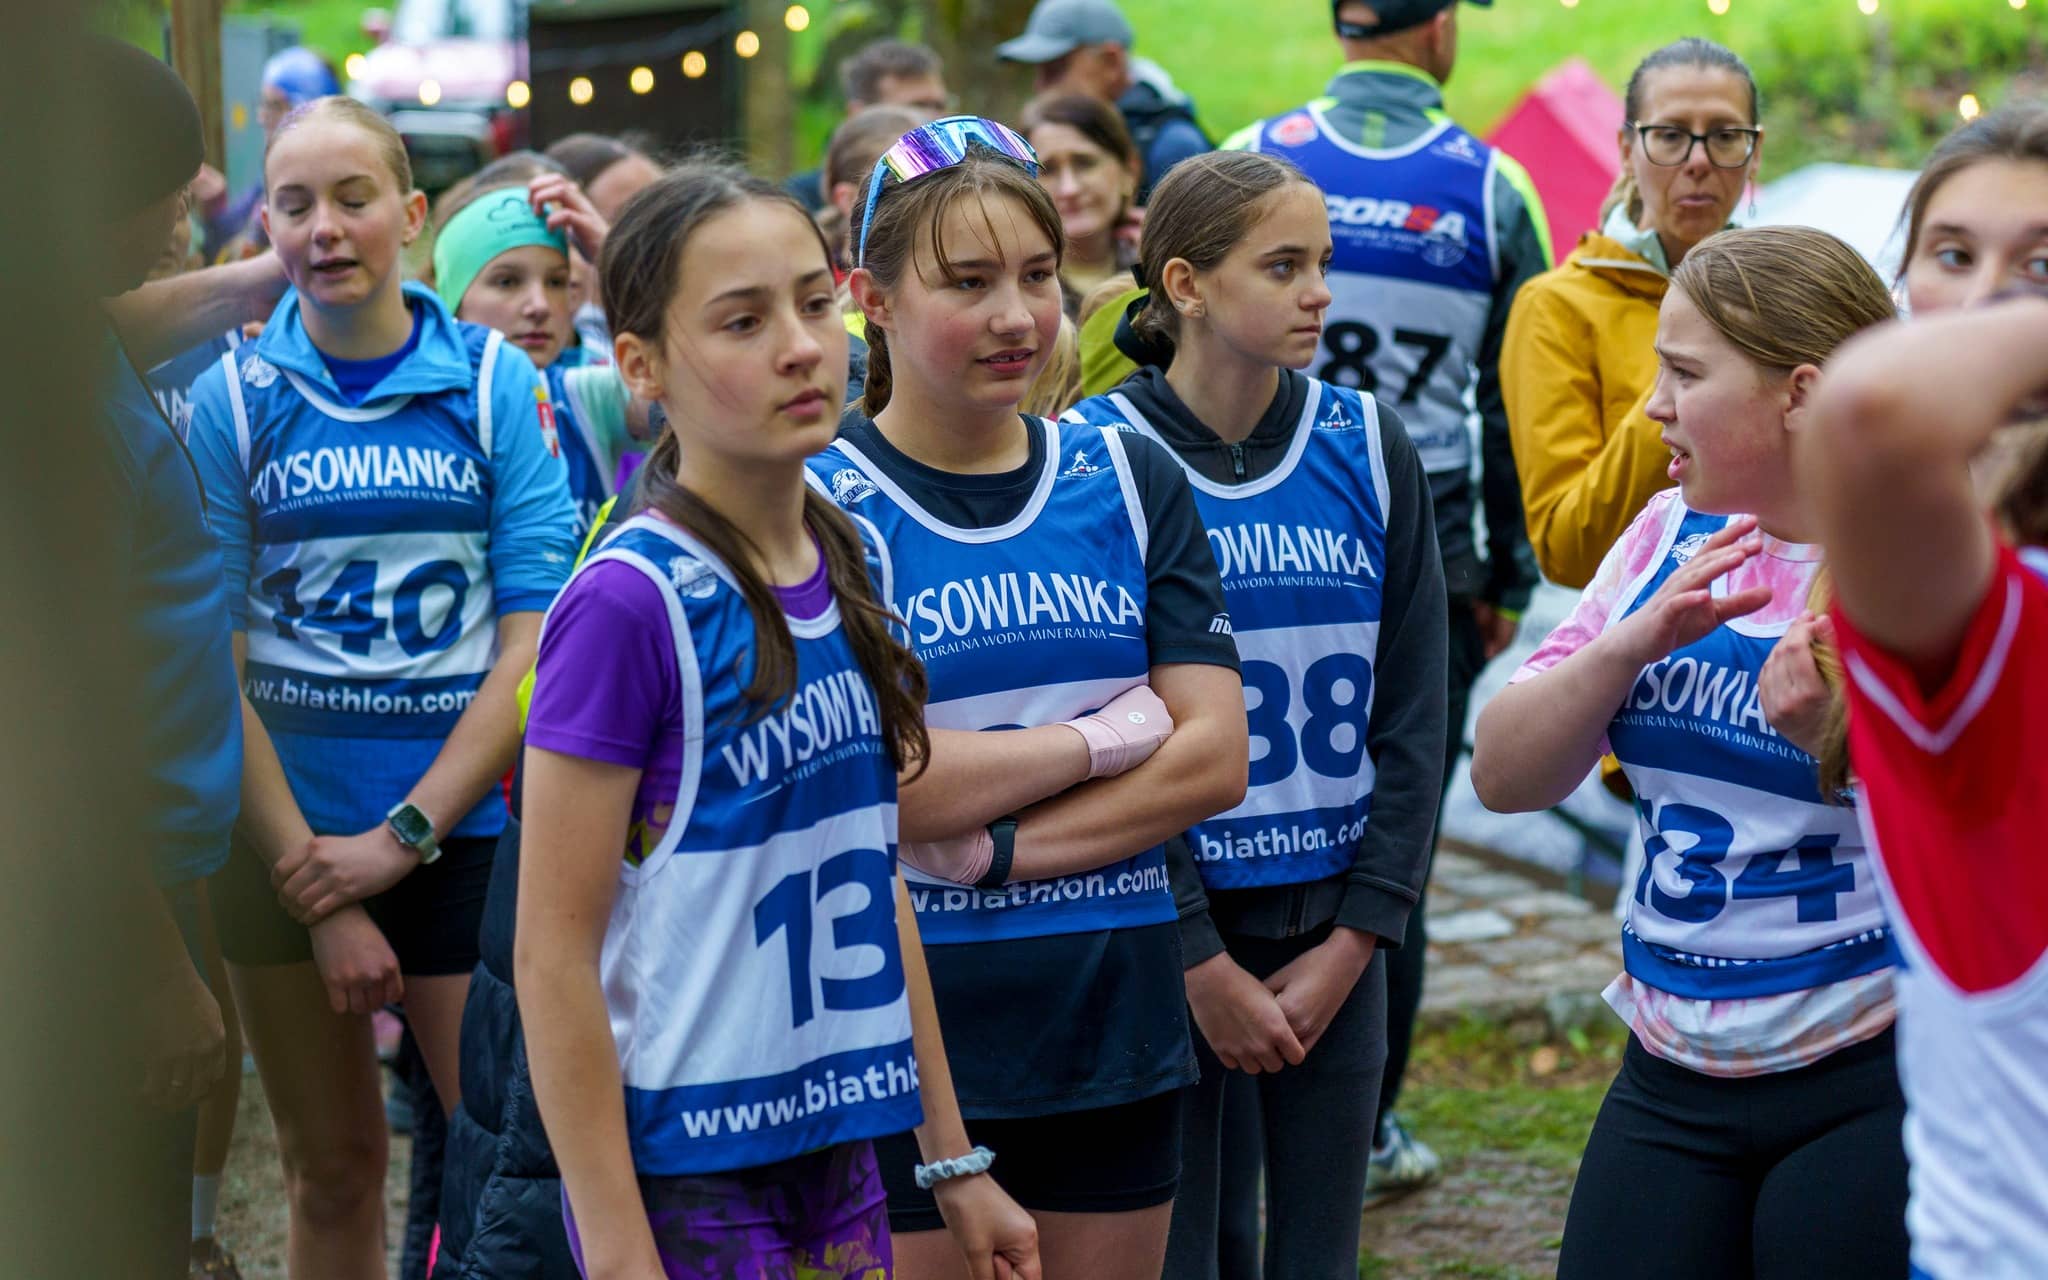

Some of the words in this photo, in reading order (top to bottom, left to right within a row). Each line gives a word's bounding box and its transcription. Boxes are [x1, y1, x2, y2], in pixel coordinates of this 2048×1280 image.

[1239, 579, 1275, 591] WODA
[1277, 576, 1341, 588] MINERALNA
[262, 559, 469, 658] 140
[982, 633, 1025, 647] WODA
[1028, 627, 1107, 642] MINERALNA
[1621, 713, 1687, 732] NATURALNA
[1689, 722, 1729, 742] WODA
[1731, 731, 1811, 766] MINERALNA
